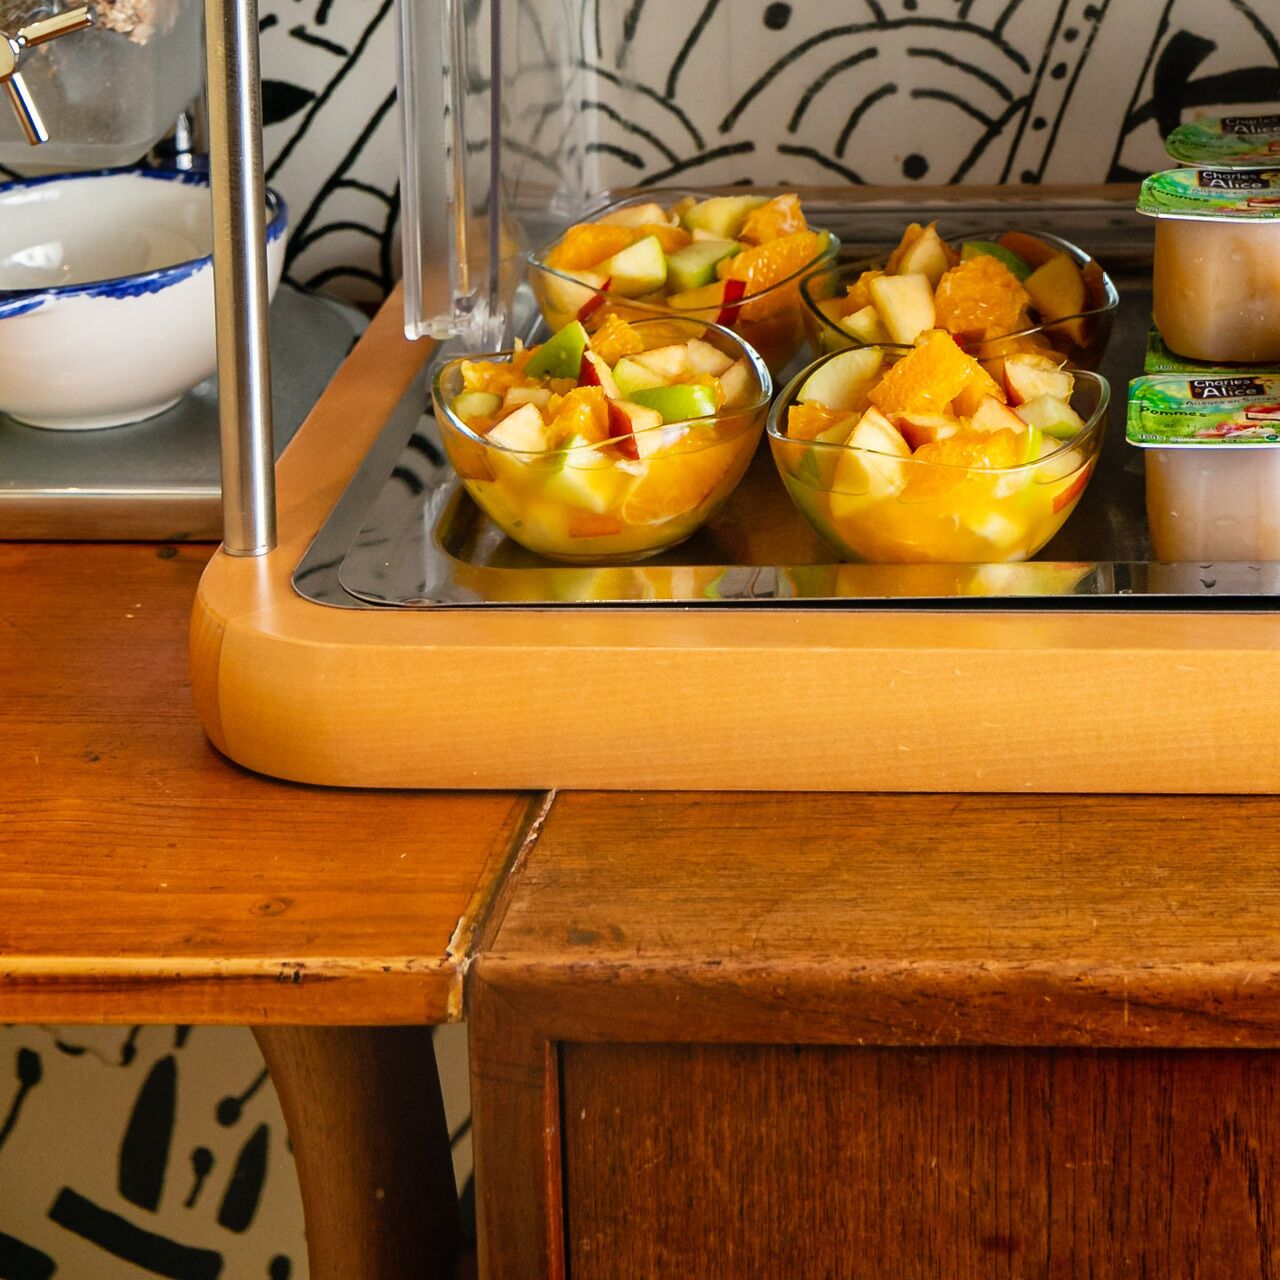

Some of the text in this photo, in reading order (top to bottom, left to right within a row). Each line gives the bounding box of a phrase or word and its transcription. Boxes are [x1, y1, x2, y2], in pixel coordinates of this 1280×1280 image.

[1203, 171, 1257, 180] Charles
[1210, 179, 1262, 189] Alice
[1194, 379, 1251, 388] Charles
[1202, 387, 1257, 399] Alice
[1141, 405, 1207, 418] Pommes
